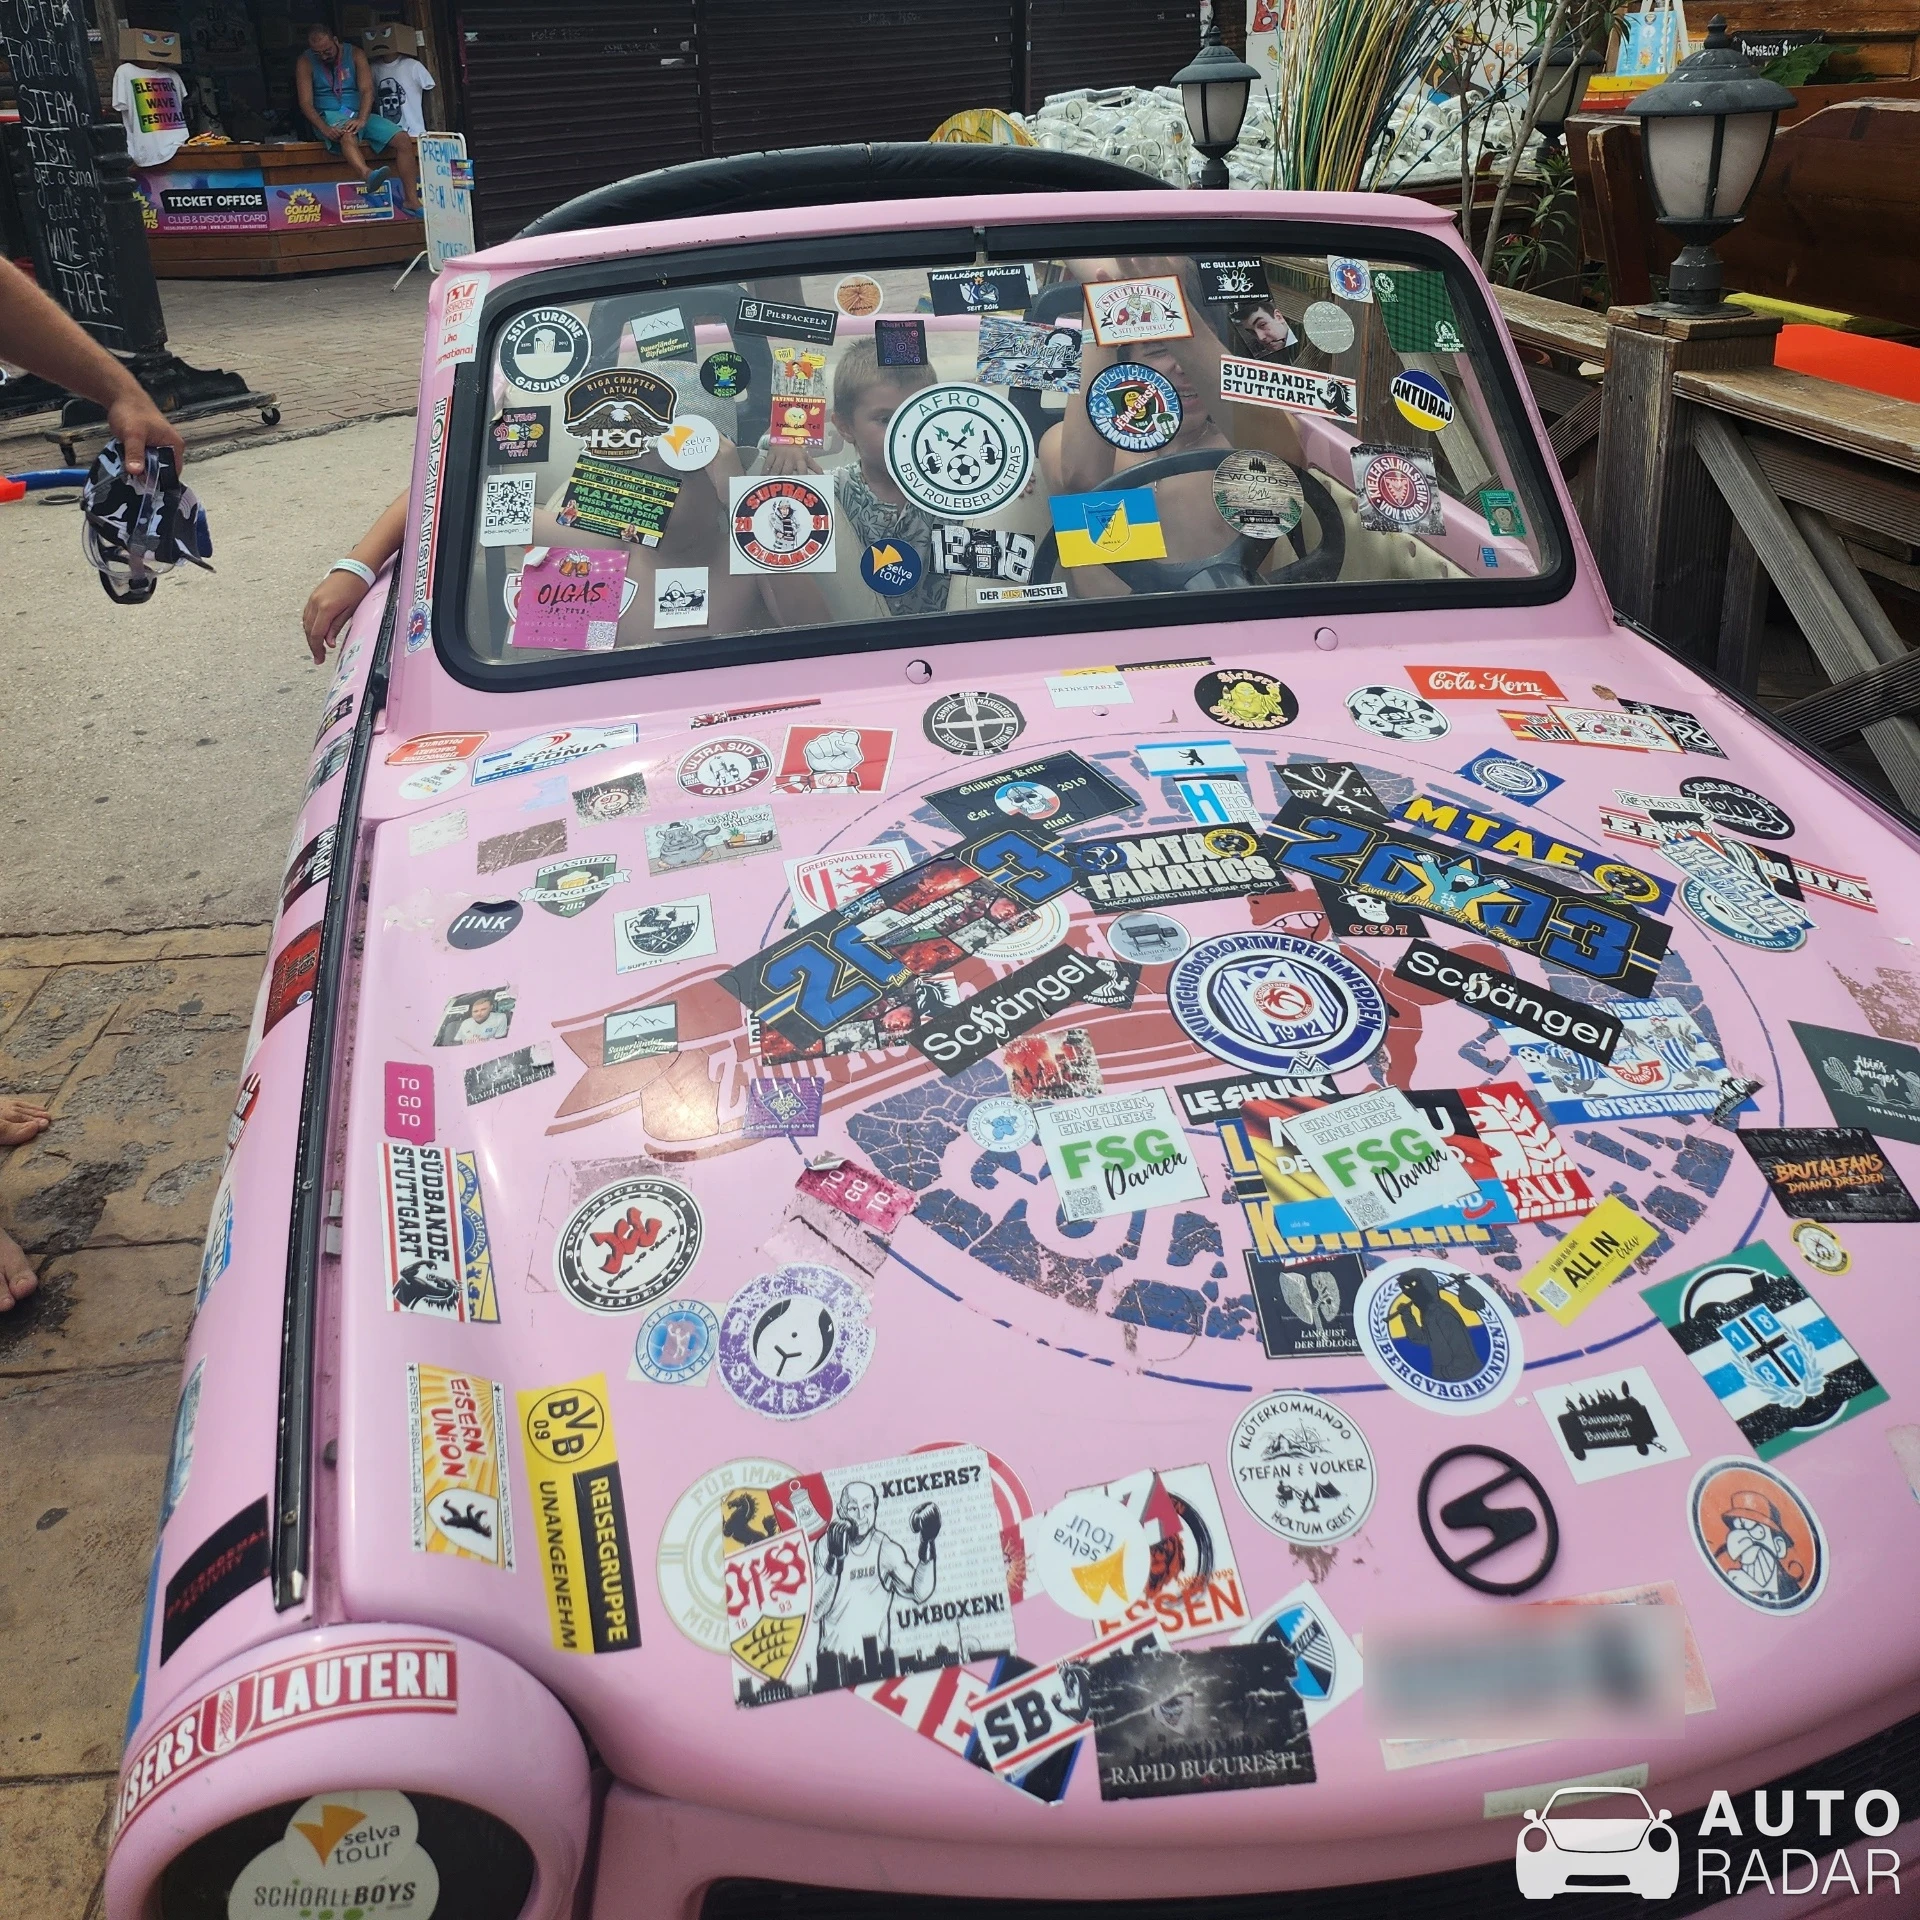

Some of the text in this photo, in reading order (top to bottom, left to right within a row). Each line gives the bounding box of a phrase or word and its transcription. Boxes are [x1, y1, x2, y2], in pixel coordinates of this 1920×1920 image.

[134, 81, 177, 94] ELECTRIC
[19, 84, 80, 128] STEAK
[146, 97, 175, 109] WAVE
[168, 194, 263, 207] TICKET OFFICE
[284, 204, 321, 216] GOLDEN
[168, 215, 191, 224] CLUB
[200, 213, 242, 224] DISCOUNT
[243, 213, 267, 223] CARD
[288, 214, 321, 224] EVENTS
[931, 266, 1021, 281] KNALLKÖPPE WÜLLEN
[57, 266, 114, 316] FREE
[1102, 286, 1170, 308] STUTTGART
[765, 309, 828, 326] PILSFACKELN
[966, 303, 999, 312] SEIT 2016
[506, 319, 528, 343] SSV
[531, 311, 583, 339] TURBINE
[640, 338, 679, 353] Sauerländer
[645, 342, 690, 358] Gipfelstürmer
[514, 373, 570, 393] GASUNG
[586, 375, 657, 393] RIGA CHAPTER
[1222, 361, 1316, 392] SÜDBANDE
[603, 386, 638, 396] LATVIA
[1222, 378, 1316, 407] STUTTGART
[1392, 379, 1453, 422] ANTURAJ
[917, 392, 981, 417] AFRO
[591, 428, 642, 448] HOG
[685, 435, 712, 447] selva
[1095, 416, 1165, 449] JAWORZNO
[681, 445, 709, 457] tour
[900, 444, 1022, 510] BSV ROLEBER ULTRAS
[1228, 473, 1289, 488] WOODS
[573, 485, 665, 515] MALLORCA
[746, 482, 819, 509] SUPRAS
[578, 495, 659, 521] UNSER MEIN DEIN
[1379, 500, 1425, 520] VON 1900
[879, 569, 907, 586] tour
[886, 563, 913, 579] selva
[537, 580, 608, 606] OLGAS
[1051, 682, 1120, 693] TRINKSTABIL
[1427, 669, 1542, 694] Cola Korn
[936, 698, 1013, 720] SEMPRE MANGIARE
[1381, 711, 1410, 722] FSV
[941, 733, 969, 749] SENESE
[990, 726, 1015, 747] ON TOUR
[494, 742, 609, 772] ESTONIA
[523, 743, 581, 759] RALLY
[684, 741, 755, 772] ULTRA SUD
[702, 777, 760, 796] GALATI
[958, 763, 1047, 796] Glühende Kette
[1056, 777, 1088, 792] 2019
[1214, 781, 1244, 796] HA
[1220, 795, 1254, 810] HO
[1701, 797, 1766, 820] 2012
[966, 808, 995, 822] Est.
[1230, 809, 1262, 824] HE
[802, 851, 893, 875] GREIFSWALDER FC
[1116, 833, 1222, 870] MTA
[541, 853, 612, 874] GLASBIER
[1087, 855, 1276, 900] FANATICS
[537, 878, 610, 901] RANGERS
[558, 900, 587, 914] 2015
[1348, 923, 1408, 936] CC97
[1734, 932, 1784, 948] DETMOLD
[397, 1077, 420, 1090] TO
[397, 1095, 422, 1108] GO
[1050, 1096, 1156, 1124] EIN VEREIN,
[1582, 1091, 1719, 1119] OSTSEESTADION
[397, 1113, 421, 1127] TO
[1060, 1108, 1157, 1136] EINE LIEBE
[1300, 1096, 1396, 1134] EIN VEREIN,
[1313, 1108, 1403, 1146] EINE LIEBE
[1060, 1128, 1177, 1181] FSG
[1322, 1127, 1435, 1188] FSG
[820, 1169, 846, 1190] TO
[1103, 1151, 1188, 1201] Damen
[1374, 1148, 1448, 1204] Damen
[1772, 1153, 1885, 1184] BRUTALFANS
[844, 1179, 870, 1203] GO
[1787, 1173, 1885, 1195] DYNAMO DRESDEN
[392, 1145, 423, 1258] STUTTGART
[419, 1147, 450, 1263] SÜDBANDE
[866, 1191, 892, 1214] TO
[565, 1183, 664, 1260] JUGENDCLUB
[1615, 1235, 1640, 1260] crew
[1563, 1230, 1620, 1289] ALL IN
[646, 1302, 718, 1333] GLASBIER
[1761, 1312, 1775, 1331] 8
[1294, 1338, 1358, 1349] DER BIOLOGE
[638, 1353, 707, 1384] RANGERS
[1379, 1324, 1508, 1402] BERGVAGABUNDEN
[1760, 1348, 1802, 1383] 8 7
[729, 1361, 823, 1410] STARS
[533, 1419, 551, 1441] 09
[1578, 1413, 1634, 1426] Bauwagen
[1584, 1428, 1631, 1442] Bawinkel
[1239, 1463, 1291, 1481] STEFAN
[1309, 1458, 1367, 1477] VOLKER
[880, 1464, 982, 1499] KICKERS?
[1271, 1504, 1357, 1535] HOLTUM GEEST
[1053, 1528, 1102, 1561] selva
[1065, 1514, 1117, 1552] tour
[539, 1480, 578, 1650] UNANGENEHM
[590, 1475, 629, 1644] REISEGRUPPE
[778, 1601, 792, 1613] 93
[897, 1593, 1006, 1629] UMBOXEN!
[734, 1619, 749, 1632] 18
[261, 1652, 448, 1722] LAUTERN
[343, 1822, 401, 1847] selva
[333, 1841, 393, 1865] tour
[254, 1881, 416, 1906] SCHORLEBOYS
